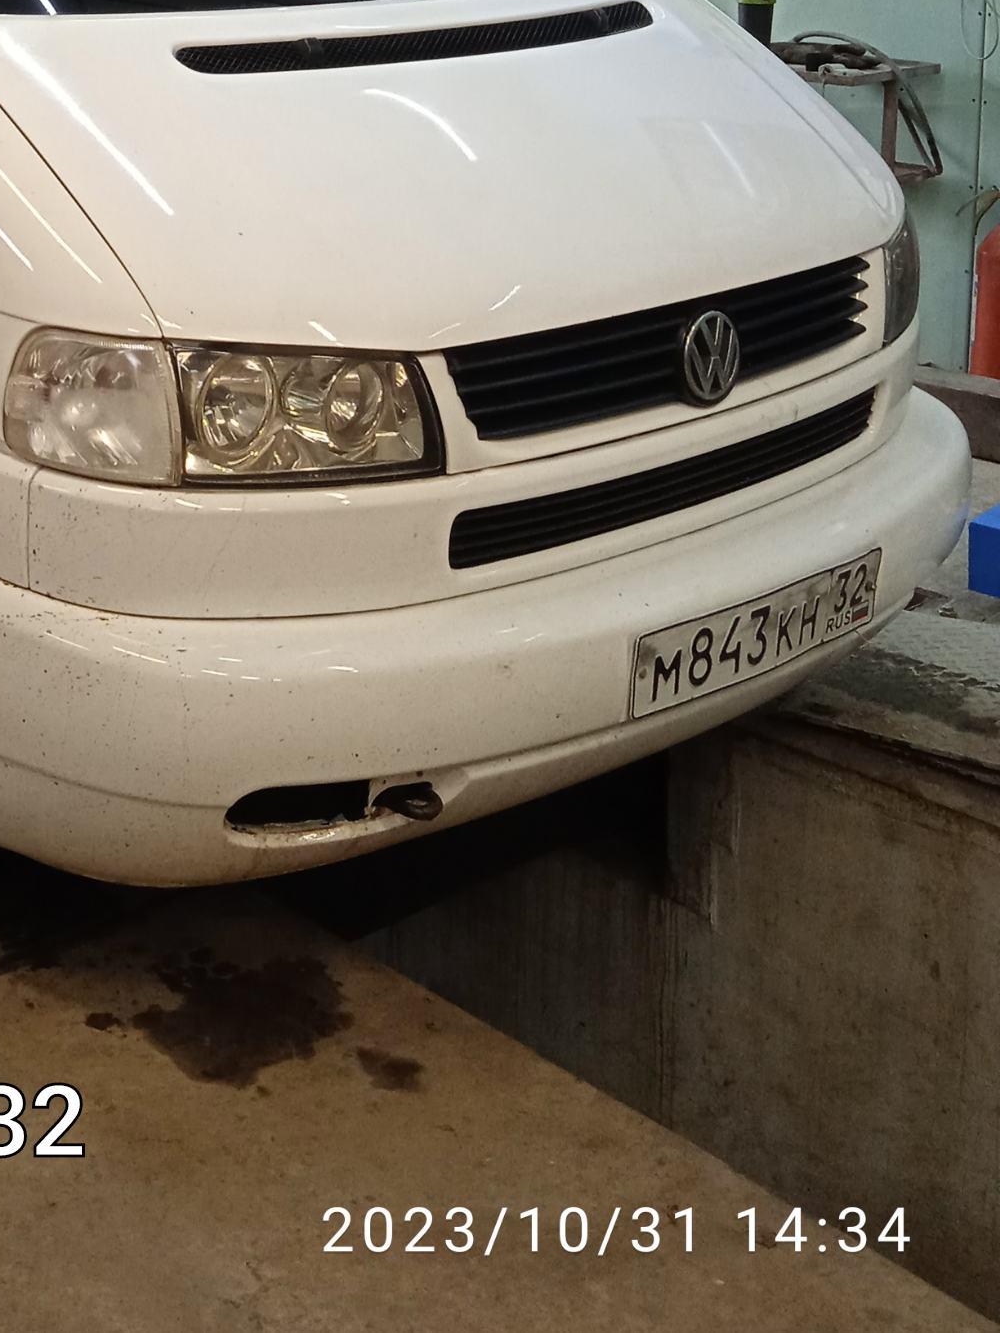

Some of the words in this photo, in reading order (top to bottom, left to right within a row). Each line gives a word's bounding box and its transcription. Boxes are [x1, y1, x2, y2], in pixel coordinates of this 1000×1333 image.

[650, 595, 822, 703] М843КН
[833, 563, 868, 613] 32
[825, 612, 853, 632] RUS
